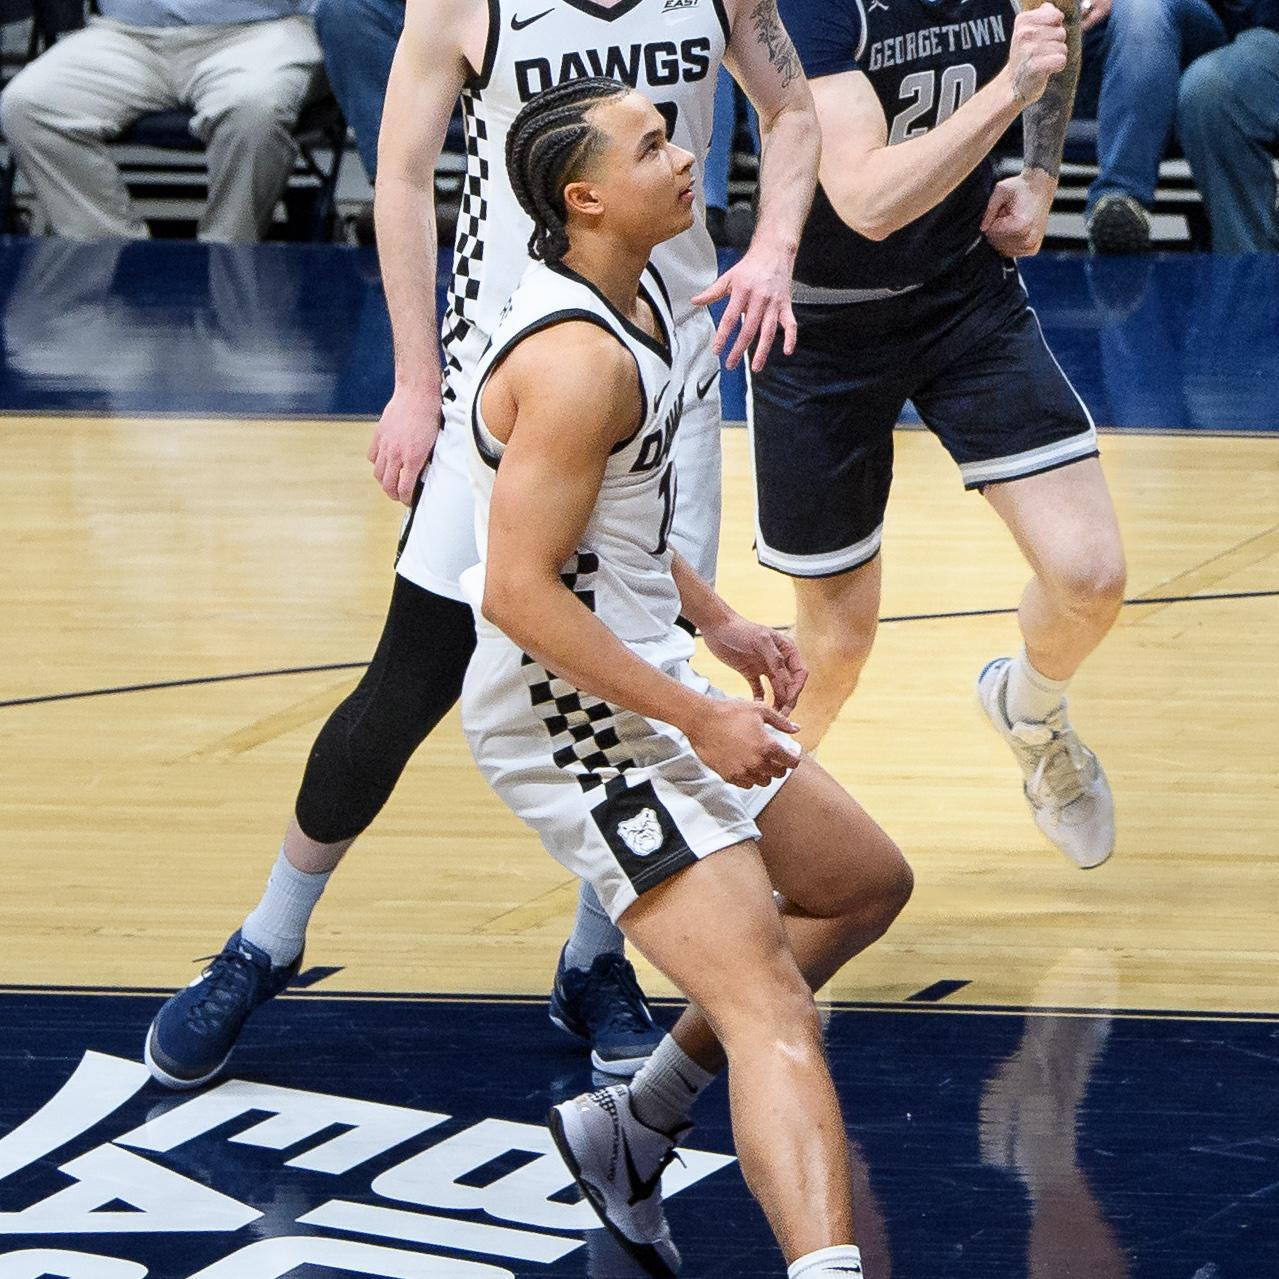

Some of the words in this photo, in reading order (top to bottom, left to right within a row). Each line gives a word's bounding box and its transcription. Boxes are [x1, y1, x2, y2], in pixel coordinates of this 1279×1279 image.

[514, 36, 711, 103] DAWGS
[869, 14, 1007, 71] GEORGETOWN
[888, 63, 977, 146] 20
